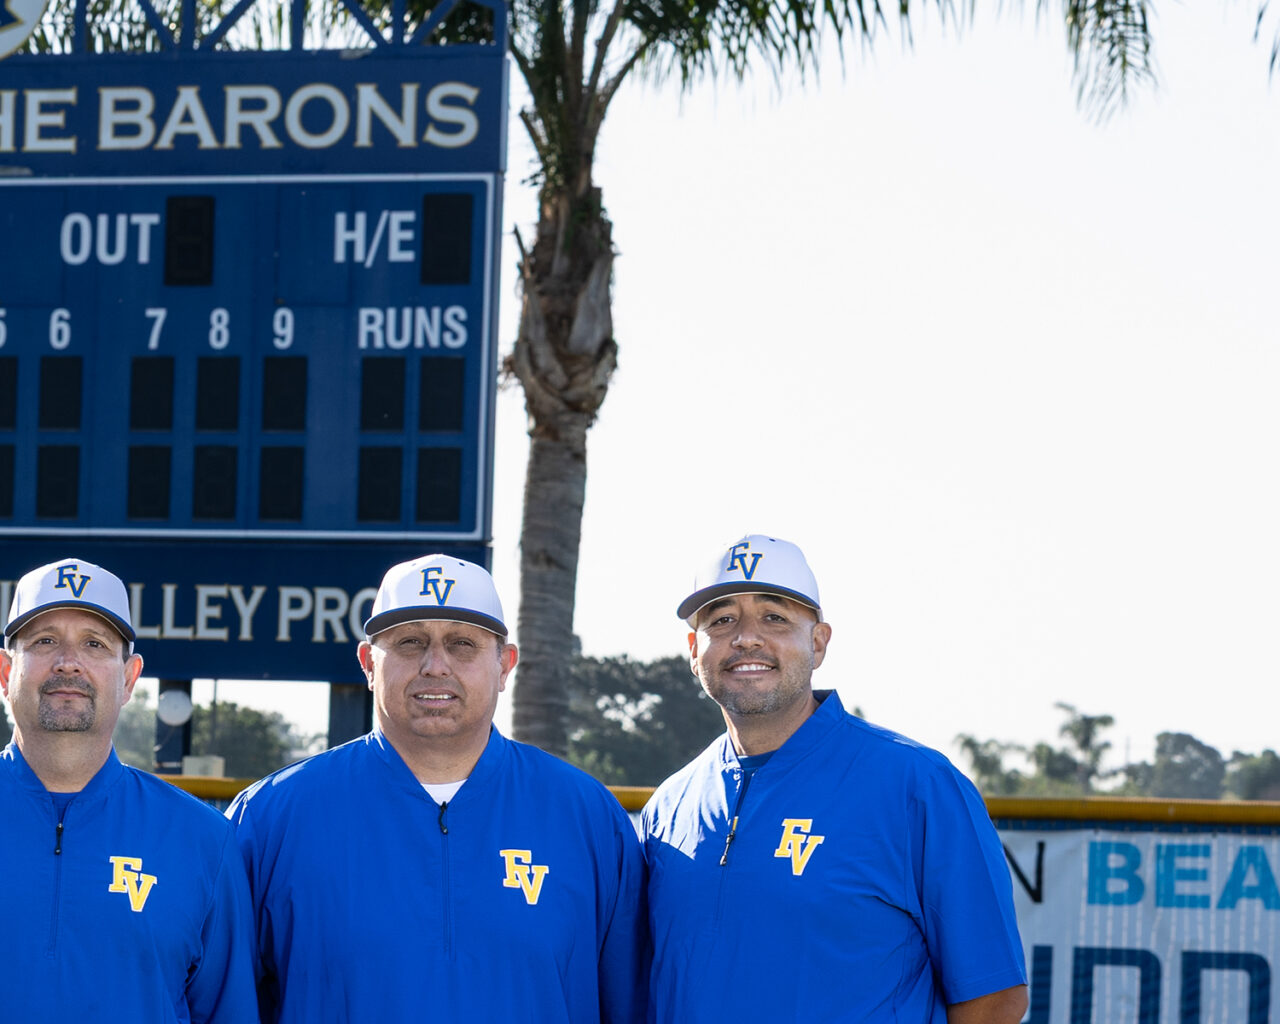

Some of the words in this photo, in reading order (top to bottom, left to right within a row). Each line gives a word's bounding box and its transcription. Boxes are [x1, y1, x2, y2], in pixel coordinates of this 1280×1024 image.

[96, 82, 480, 150] BARONS
[60, 213, 160, 265] OUT
[333, 209, 416, 268] H/E
[49, 308, 71, 350] 6
[145, 308, 167, 350] 7
[208, 307, 230, 350] 8
[273, 307, 295, 350] 9
[358, 306, 468, 350] RUNS
[55, 564, 90, 598] FV
[419, 566, 456, 606] FV
[726, 541, 762, 580] FV
[128, 582, 266, 642] LLEY
[773, 818, 825, 876] FV
[109, 855, 158, 913] FV
[497, 849, 549, 906] FV
